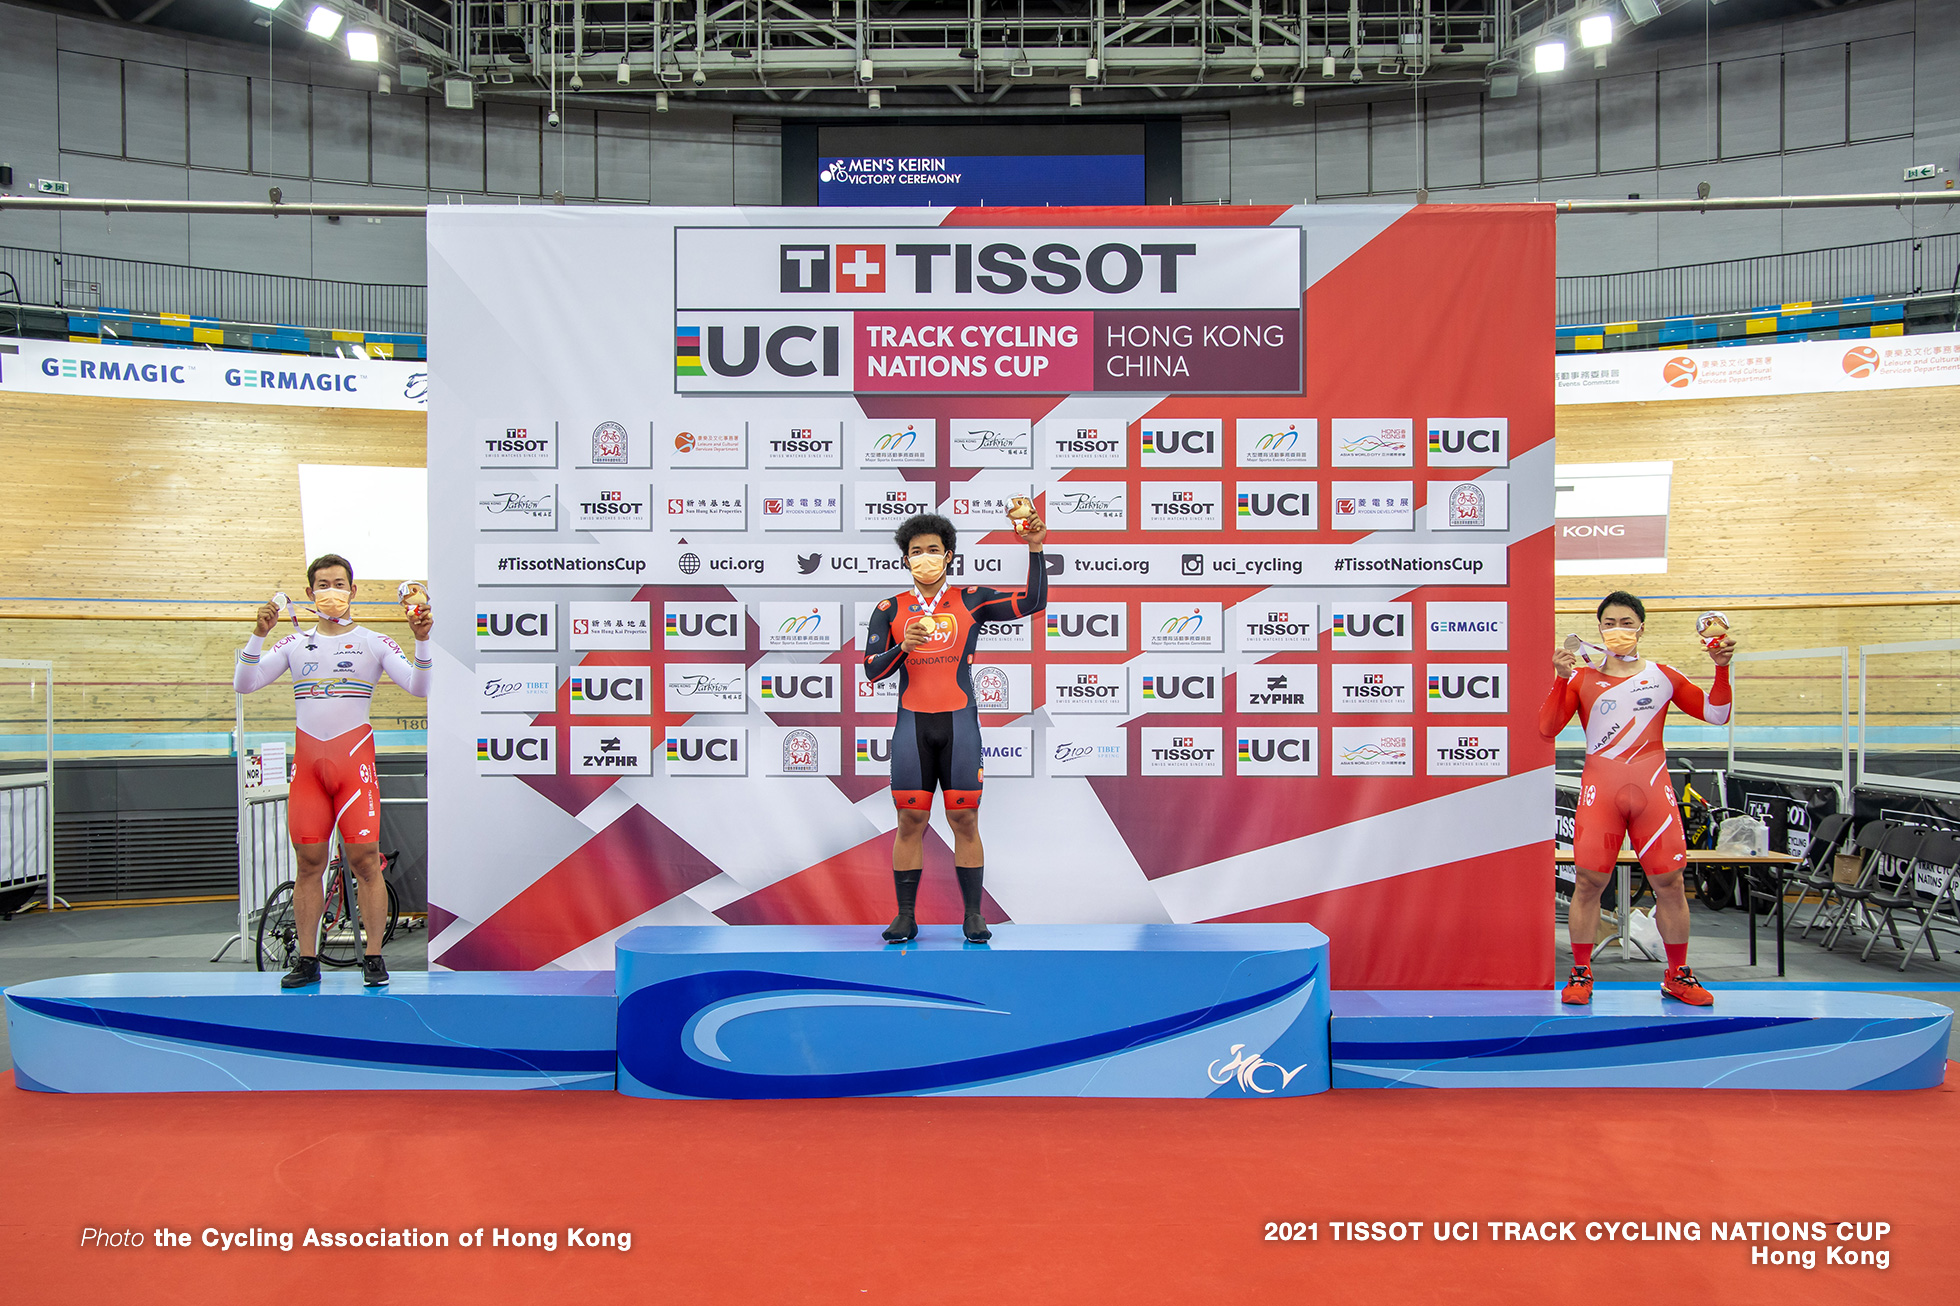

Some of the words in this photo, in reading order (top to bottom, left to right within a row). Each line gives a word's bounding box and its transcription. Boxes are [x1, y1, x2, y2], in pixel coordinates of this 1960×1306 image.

[849, 159, 892, 172] MEN'S
[897, 159, 946, 172] KEIRIN
[848, 174, 895, 185] VICTORY
[898, 174, 962, 185] CEREMONY
[895, 242, 1197, 295] TISSOT
[866, 325, 954, 348] TRACK
[959, 325, 1078, 348] CYCLING
[1107, 325, 1193, 348] HONG
[1203, 325, 1285, 348] KONG
[706, 325, 839, 377] UCI
[41, 357, 185, 385] GERMAGIC
[866, 355, 987, 378] NATIONS
[994, 355, 1049, 378] CUP
[1106, 355, 1190, 378] CHINA
[225, 367, 357, 392] GERMAGIC
[1558, 380, 1581, 388] Events
[1583, 378, 1620, 387] Committee
[485, 440, 548, 452] TISSOT
[770, 440, 833, 452] TISSOT
[1055, 440, 1119, 452] TISSOT
[1155, 431, 1214, 454] UCI
[1441, 430, 1500, 453] UCI
[580, 502, 643, 514] TISSOT
[865, 503, 928, 515] TISSOT
[1151, 503, 1214, 515] TISSOT
[1251, 493, 1310, 516] UCI
[1562, 525, 1625, 538] KONG
[498, 557, 646, 574] #TissotNationsCup
[709, 557, 764, 573] uci.org
[974, 559, 1001, 572] UCI
[1075, 557, 1150, 574] tv.uci.org
[1212, 557, 1303, 575] uci_cycling
[1334, 557, 1483, 574] #TissotNationsCup
[490, 613, 548, 636] UCI
[679, 613, 738, 636] UCI
[979, 623, 1024, 635] SSOT
[1060, 614, 1119, 637] UCI
[1246, 624, 1310, 635] TISSOT
[1346, 613, 1405, 637] UCI
[1431, 621, 1498, 632] GERMAGIC
[906, 655, 960, 665] FOUNDATION
[584, 677, 643, 701] UCI
[774, 675, 833, 699] UCI
[1056, 686, 1119, 698] TISSOT
[1156, 676, 1214, 699] UCI
[1342, 685, 1405, 697] TISSOT
[1441, 675, 1499, 699] UCI
[1630, 684, 1660, 693] JAPAN
[1249, 693, 1304, 705] ZYPHR
[402, 719, 428, 730] 180
[1593, 723, 1621, 751] JAPAN
[490, 738, 548, 761] UCI
[680, 738, 738, 761] UCI
[982, 746, 1022, 757] MAGIC
[1151, 748, 1214, 760] TISSOT
[1251, 739, 1310, 762] UCI
[1437, 748, 1500, 760] TISSOT
[583, 755, 638, 767] ZYPHR
[246, 769, 260, 779] NOR
[1884, 854, 1912, 878] UC
